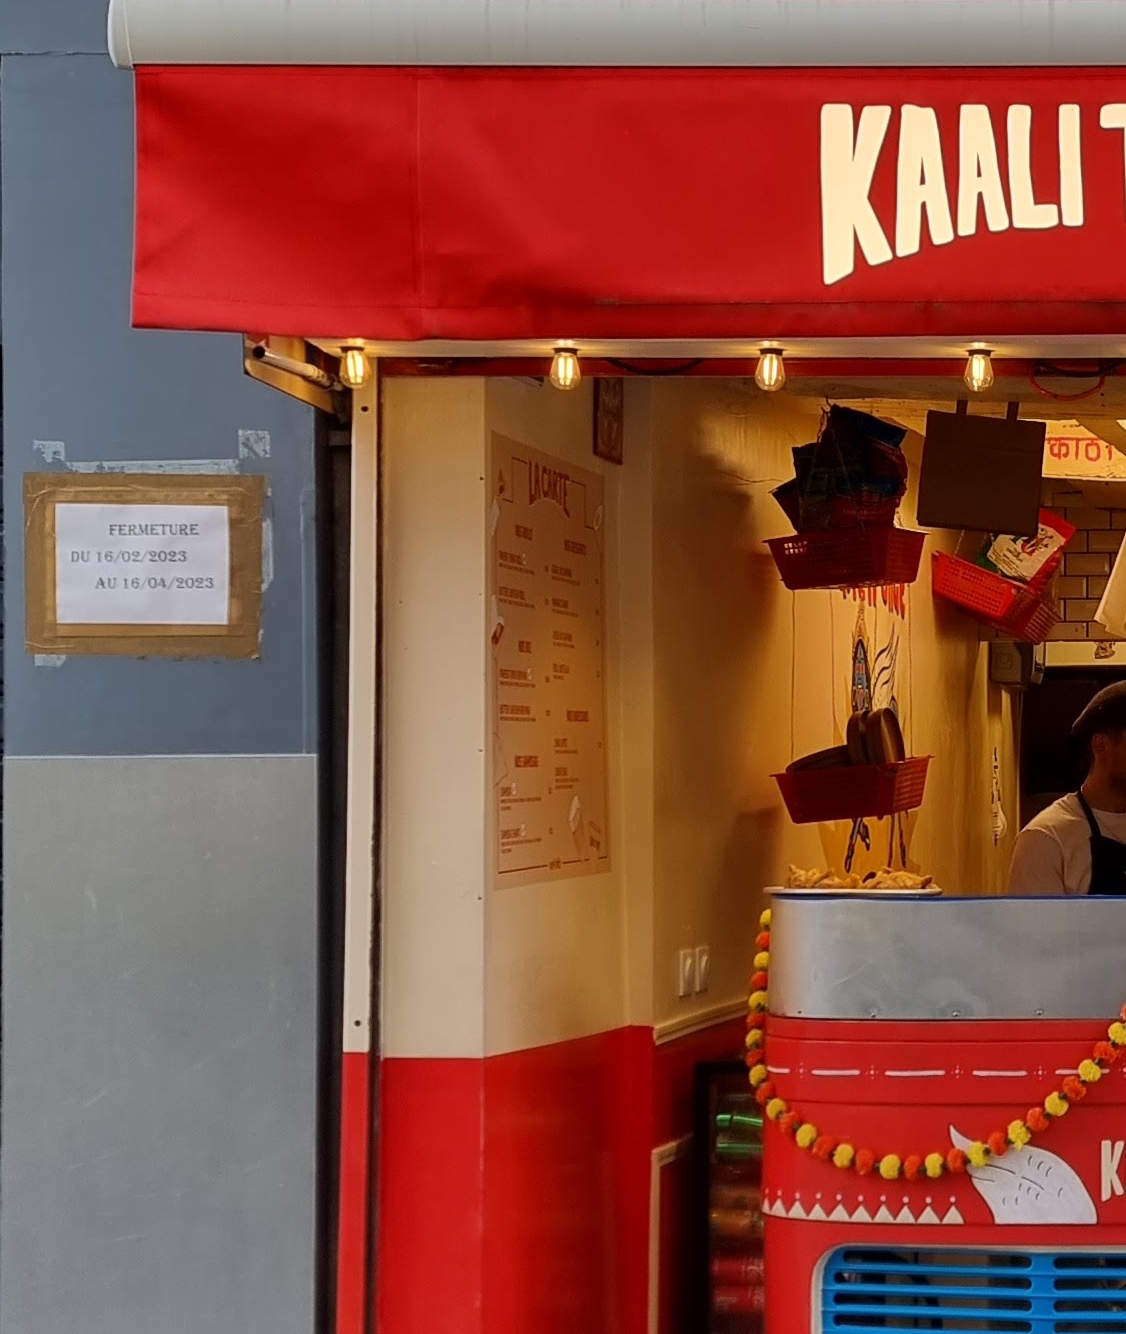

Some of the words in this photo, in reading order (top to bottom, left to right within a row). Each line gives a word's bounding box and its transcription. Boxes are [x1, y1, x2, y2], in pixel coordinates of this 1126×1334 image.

[820, 103, 1084, 285] KAALI
[108, 523, 200, 536] FERMETURE
[70, 550, 91, 563] DU
[96, 550, 188, 564] 16/02/2023
[95, 577, 117, 590] AU
[123, 577, 215, 591] 16/04/2023
